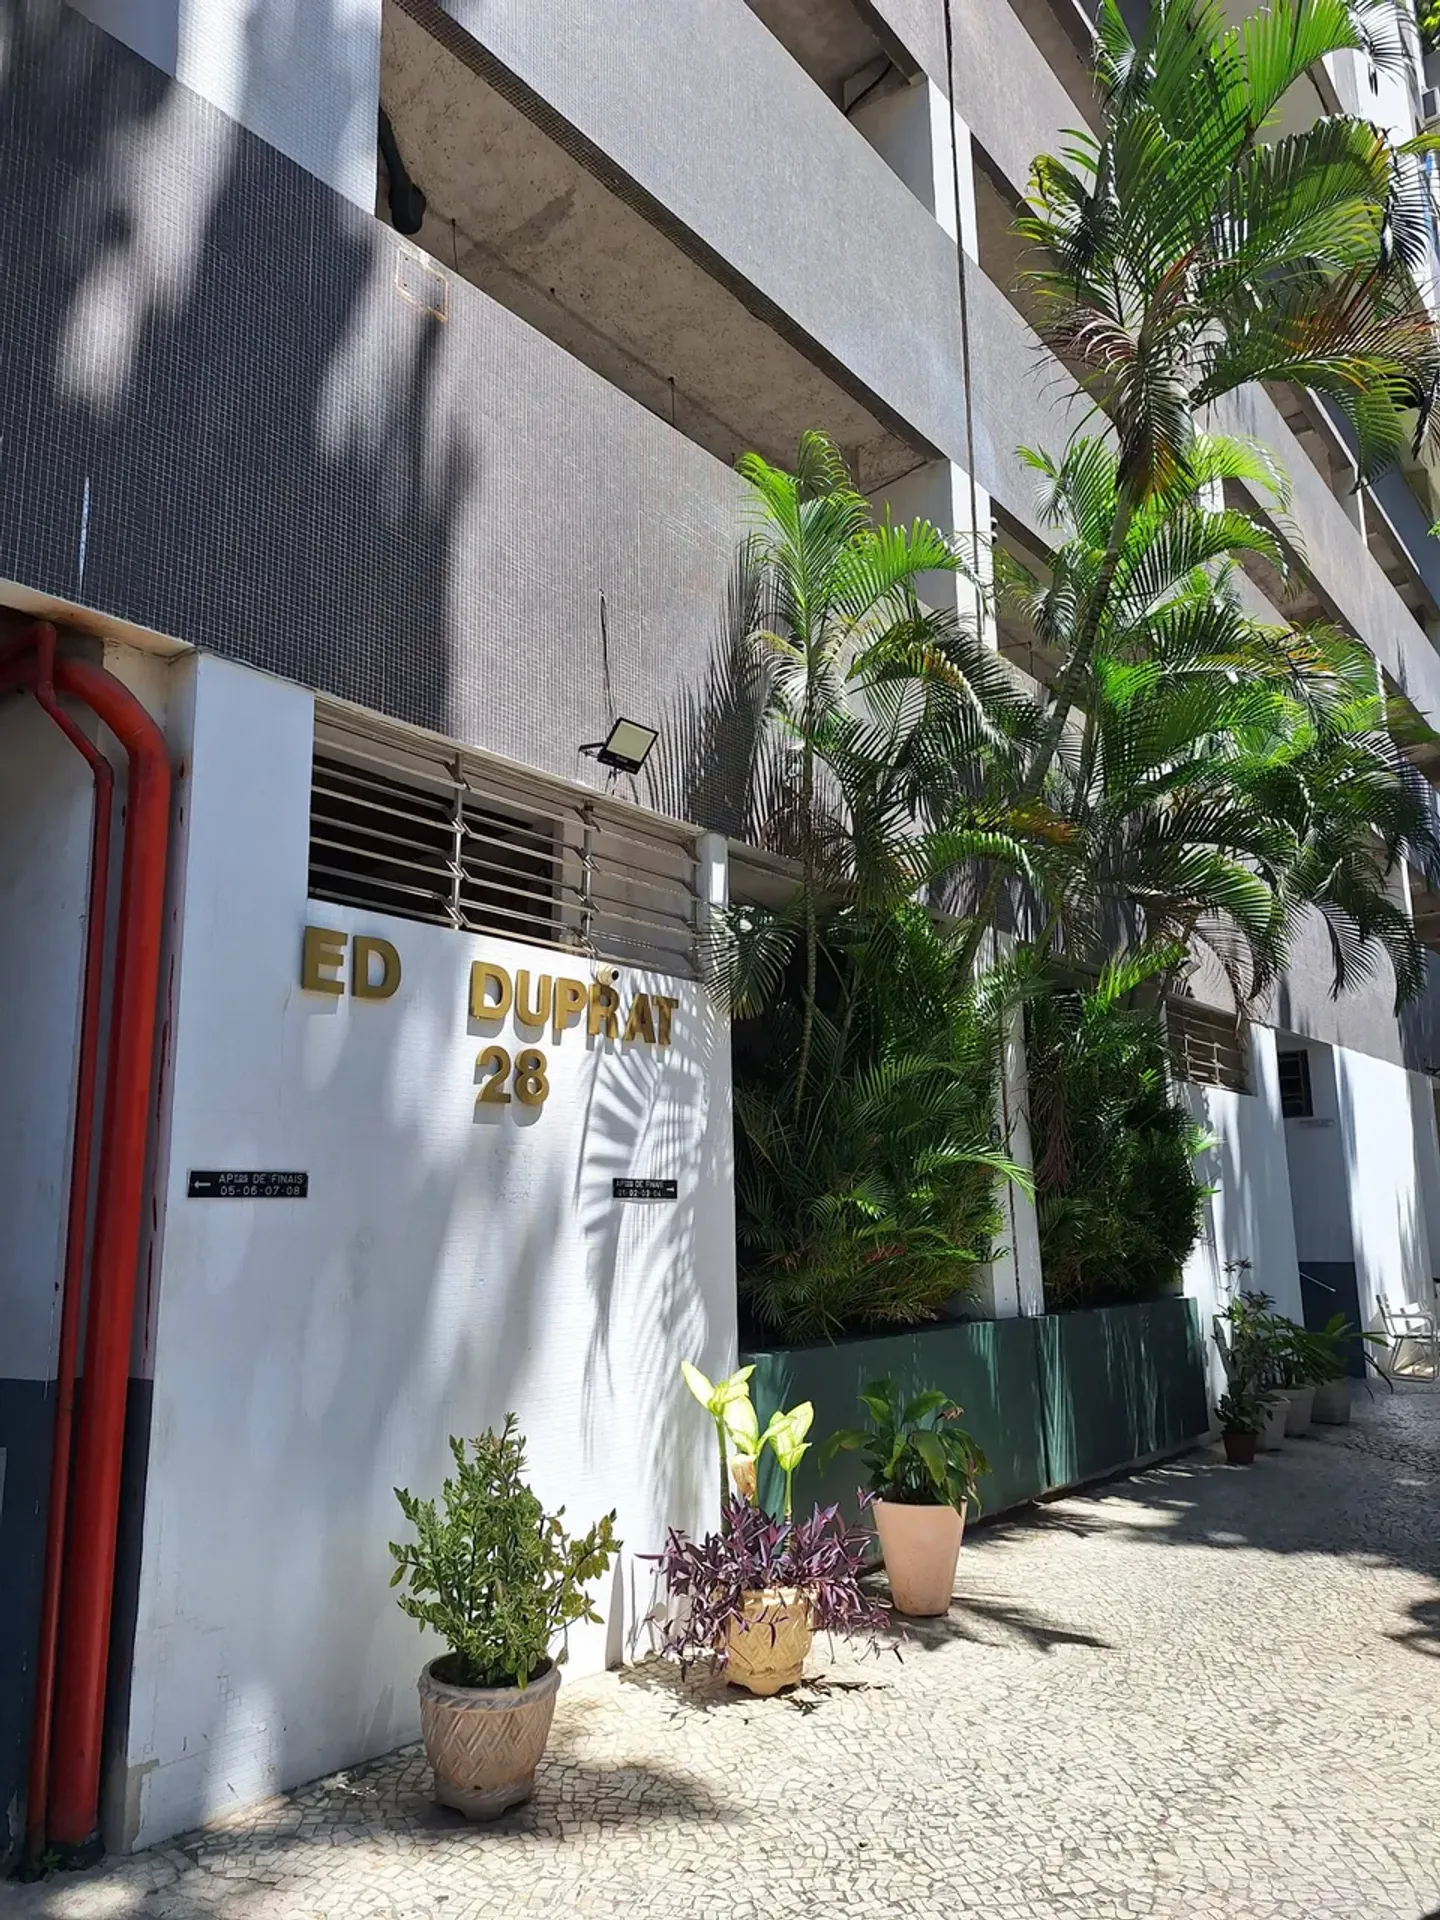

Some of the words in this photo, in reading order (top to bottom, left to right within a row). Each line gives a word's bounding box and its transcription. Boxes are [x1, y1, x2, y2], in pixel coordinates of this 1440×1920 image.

[301, 925, 402, 1000] ED
[471, 959, 681, 1046] DUPRAT
[475, 1045, 550, 1106] 28
[252, 1173, 267, 1184] DE
[271, 1174, 304, 1185] FINAIS
